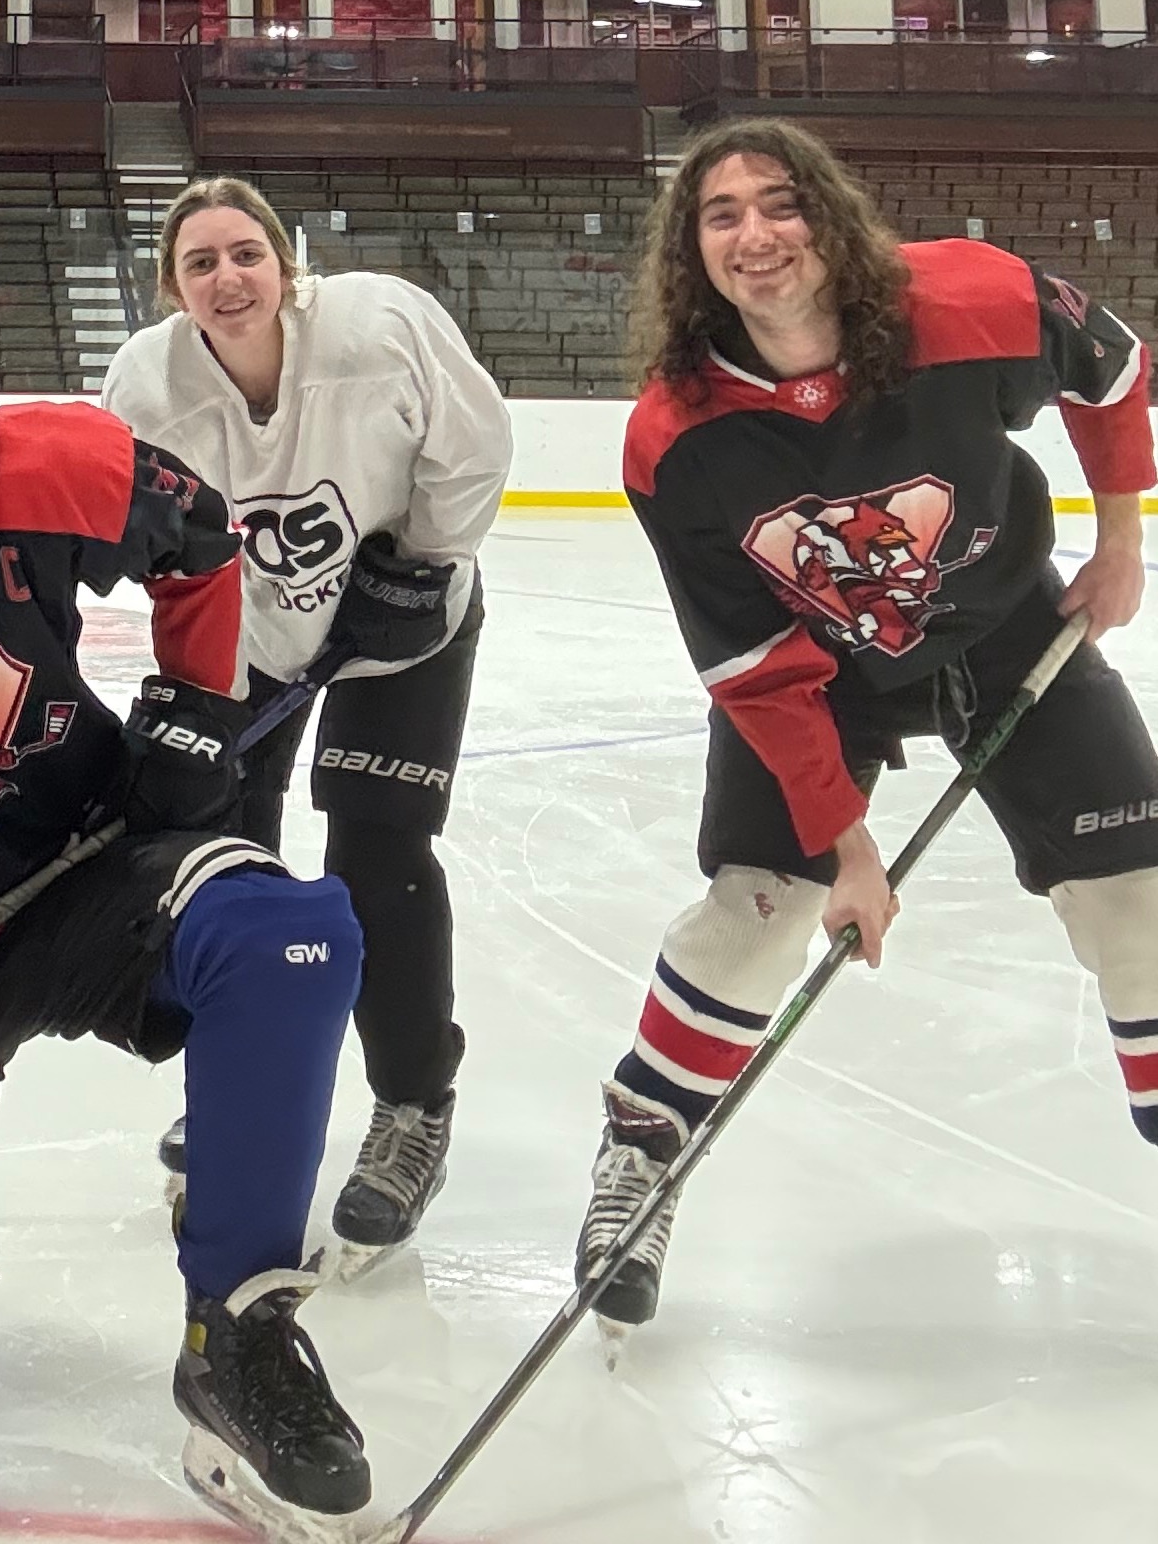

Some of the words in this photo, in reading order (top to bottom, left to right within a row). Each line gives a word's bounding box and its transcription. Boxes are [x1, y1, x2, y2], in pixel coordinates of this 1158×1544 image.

[0, 545, 32, 602] C
[356, 567, 441, 609] UER
[149, 686, 176, 703] 29
[318, 747, 449, 791] BAUER
[285, 941, 328, 964] GW
